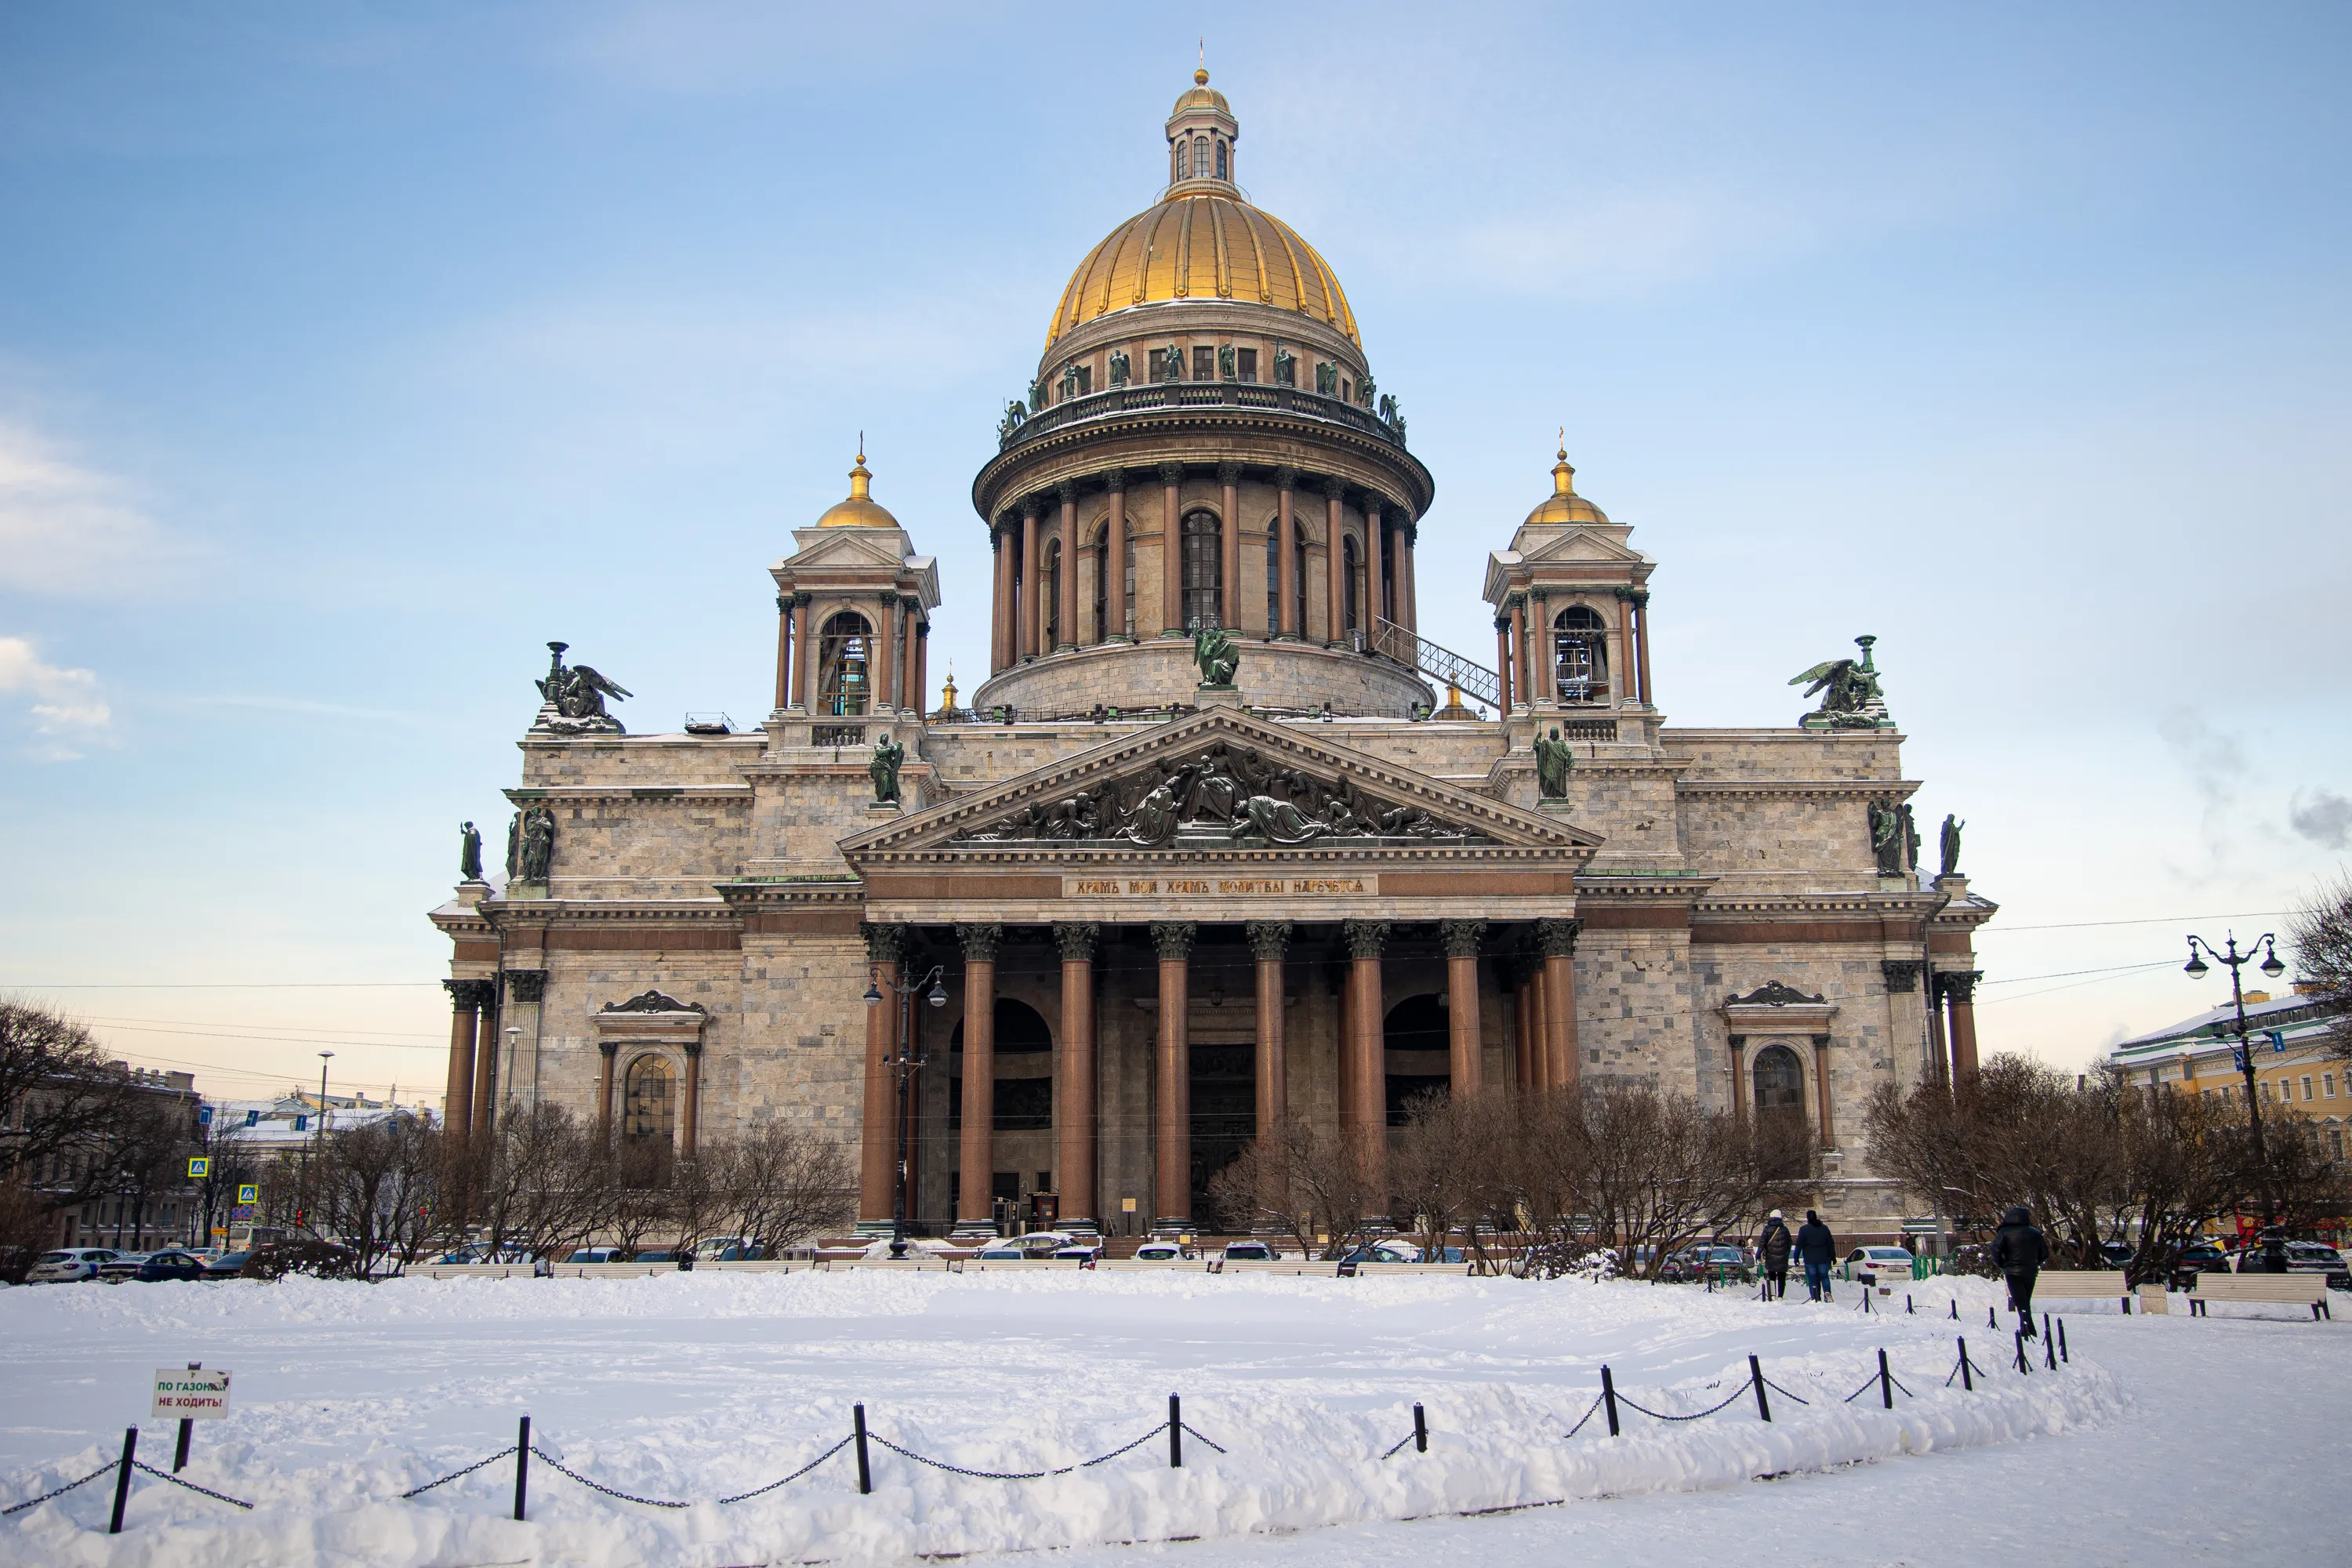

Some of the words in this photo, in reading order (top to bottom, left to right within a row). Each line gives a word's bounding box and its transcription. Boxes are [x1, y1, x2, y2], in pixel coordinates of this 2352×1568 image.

[158, 1381, 173, 1391] ПО
[158, 1397, 172, 1406] НЕ
[176, 1398, 222, 1408] ХОДИТЬ!
